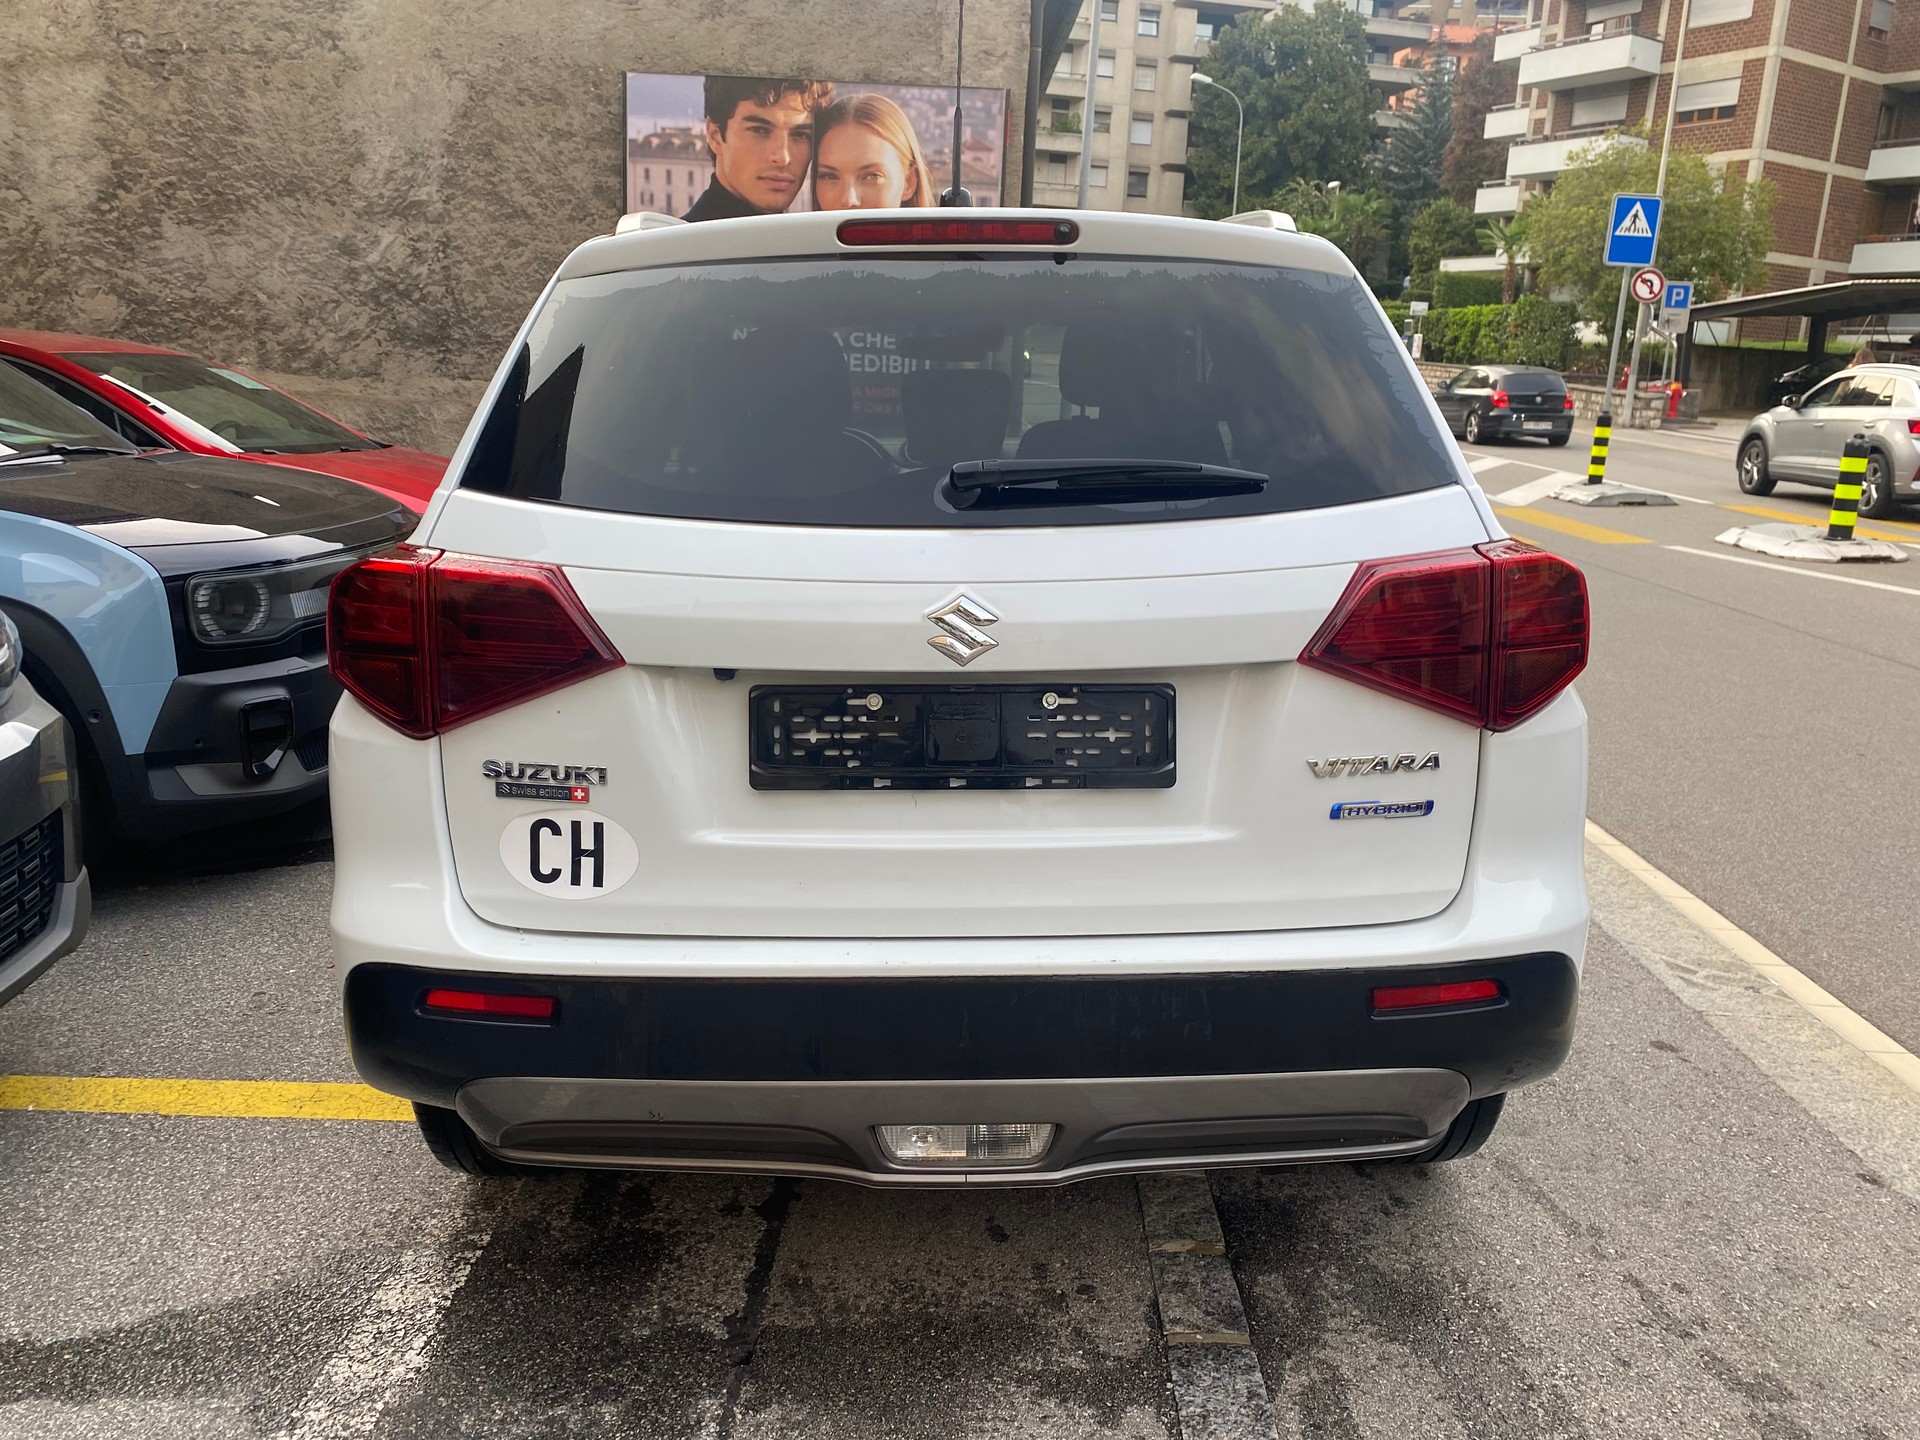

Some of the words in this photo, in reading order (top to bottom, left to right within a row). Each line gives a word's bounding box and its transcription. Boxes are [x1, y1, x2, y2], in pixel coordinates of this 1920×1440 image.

[1671, 288, 1685, 306] P
[850, 331, 896, 349] CHE
[482, 759, 608, 786] SUZUKI
[1307, 751, 1441, 779] VITARA
[511, 786, 537, 796] swiss
[539, 786, 570, 798] edition
[1347, 803, 1424, 817] HYBRID
[529, 818, 605, 888] CH
